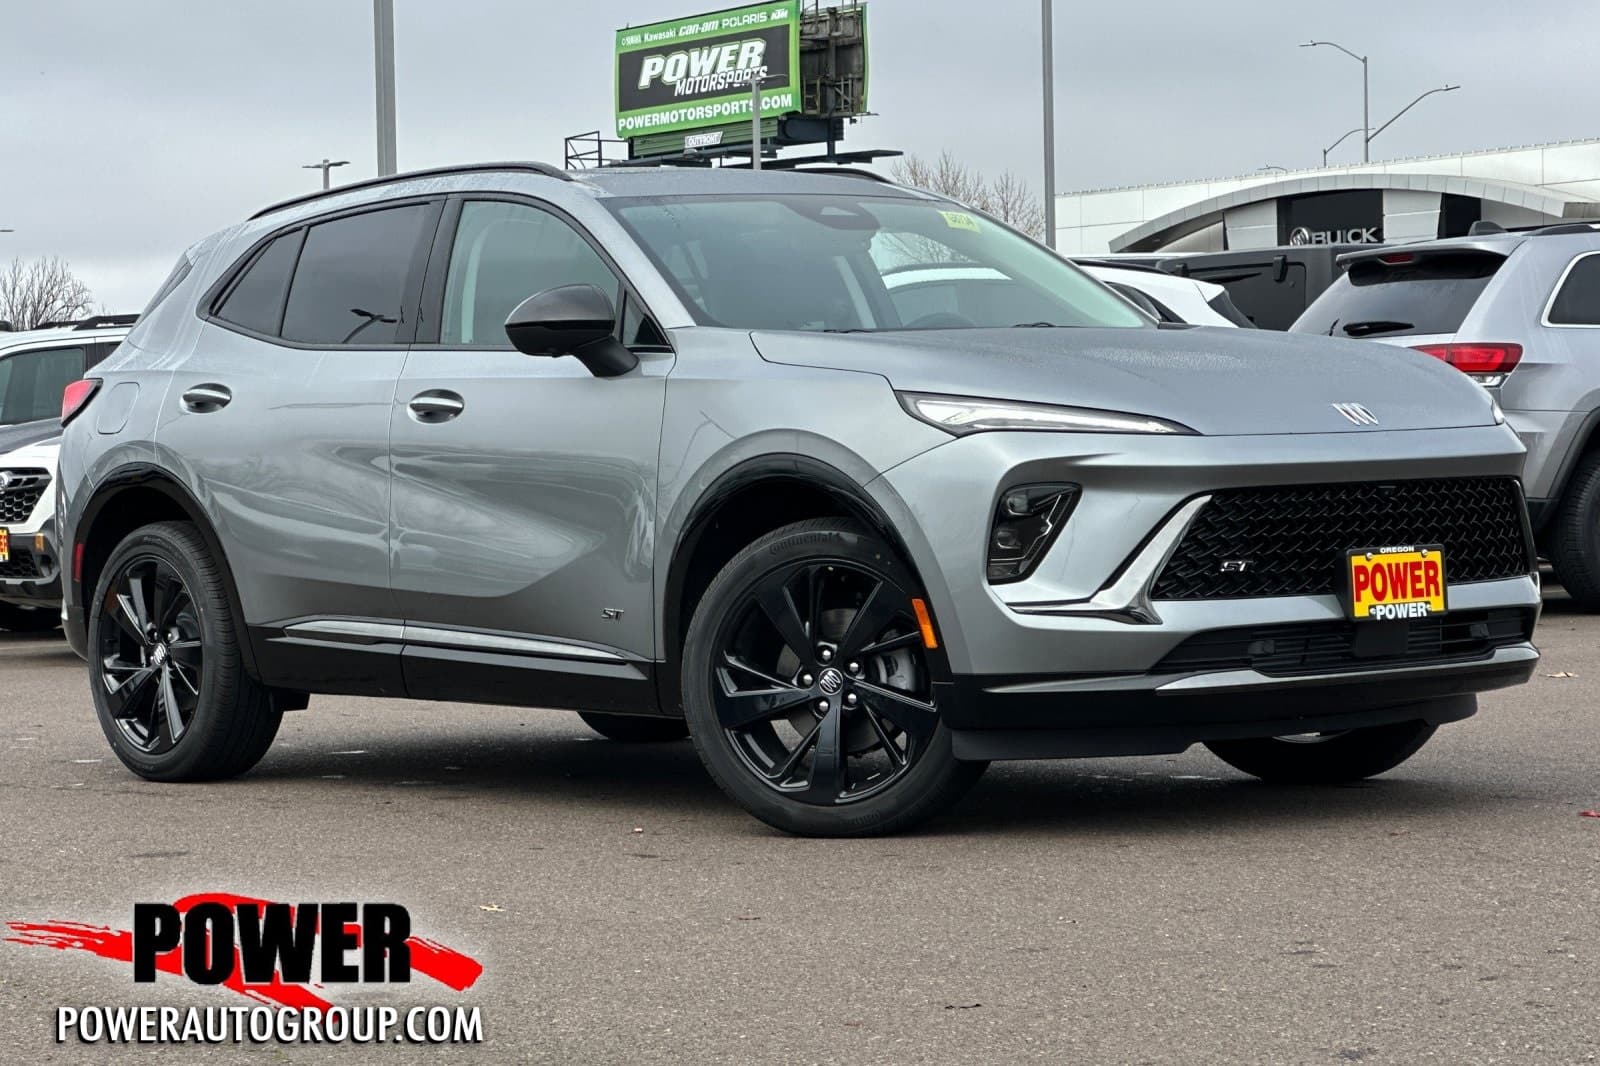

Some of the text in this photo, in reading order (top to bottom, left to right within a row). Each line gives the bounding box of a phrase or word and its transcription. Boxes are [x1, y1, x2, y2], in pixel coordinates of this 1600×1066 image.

[644, 28, 676, 43] Kawasaki
[722, 11, 768, 29] POLARIS
[770, 8, 788, 20] KTM
[638, 38, 767, 90] POWER
[674, 65, 768, 97] MOTORSPORTS
[618, 93, 792, 131] POWERMOTORSPORTSCOM
[1312, 226, 1378, 245] BUICK
[1380, 546, 1414, 554] OREGON
[1353, 560, 1441, 603] POWER
[601, 607, 625, 620] ST
[1376, 602, 1428, 620] POWER
